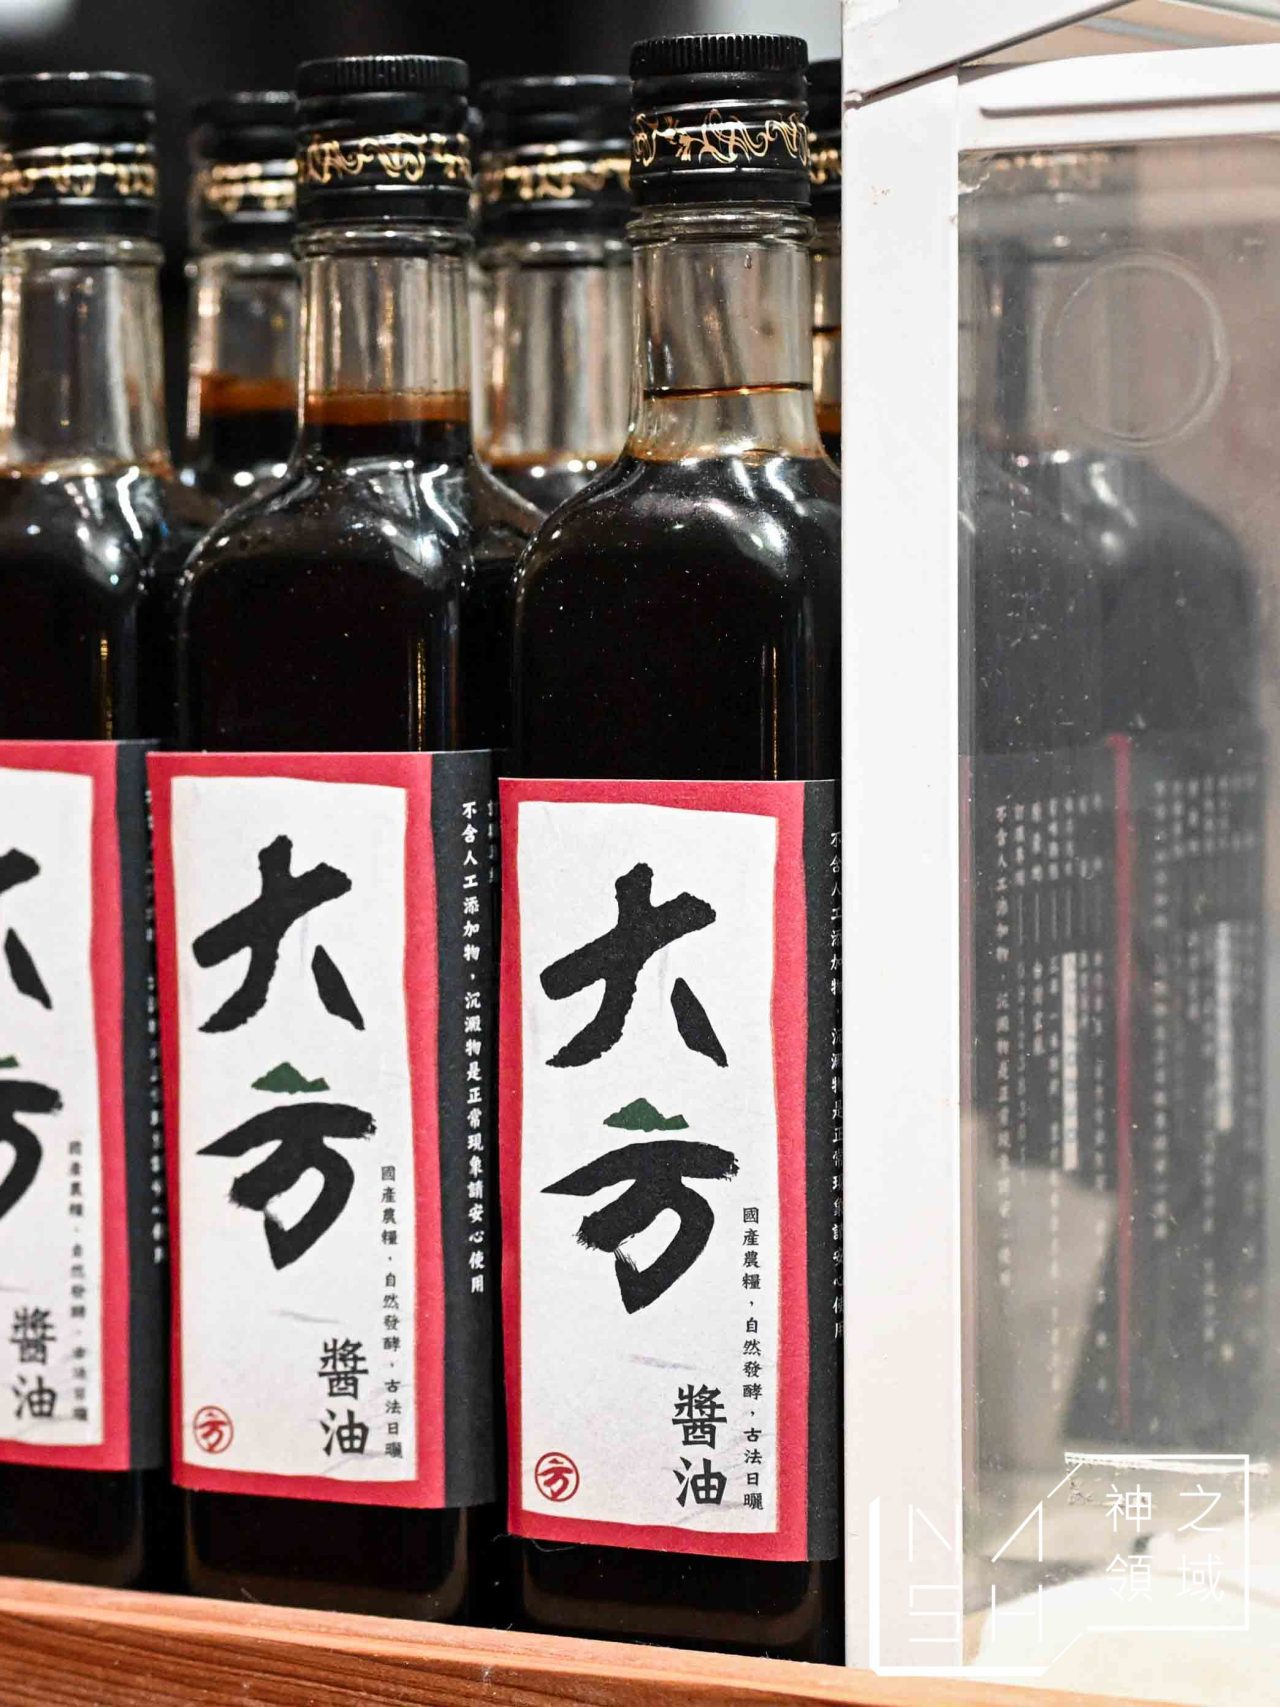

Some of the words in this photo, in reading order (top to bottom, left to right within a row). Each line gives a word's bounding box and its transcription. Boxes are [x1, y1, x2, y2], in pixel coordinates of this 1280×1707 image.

[193, 835, 376, 1270] 大方
[540, 862, 739, 1315] 大方
[11, 1307, 57, 1419] 醬油
[318, 1338, 370, 1456] 醬油
[671, 1384, 728, 1508] 醬油
[742, 1206, 763, 1511] 國產農糧，自然發酵，古法日曬
